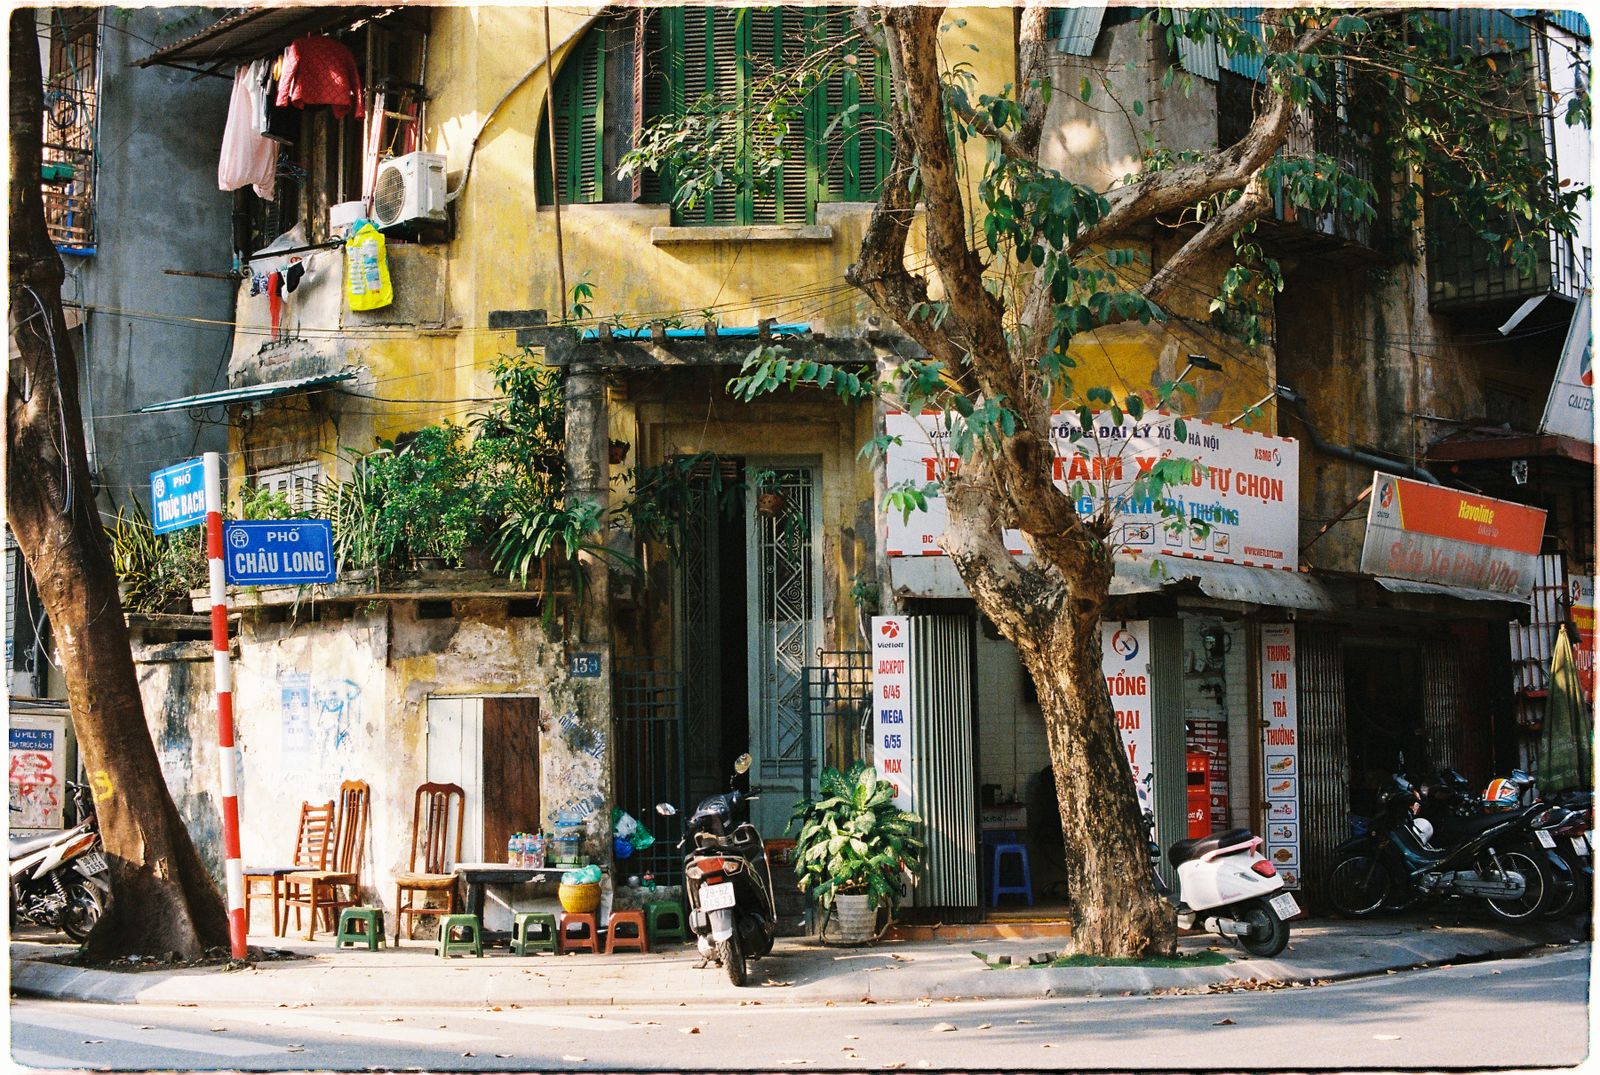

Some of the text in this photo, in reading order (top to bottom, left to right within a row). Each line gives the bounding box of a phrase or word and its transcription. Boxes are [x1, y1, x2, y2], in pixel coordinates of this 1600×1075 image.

[1099, 426, 1127, 441] ĐẠI
[1133, 424, 1151, 438] LÝ
[1203, 435, 1220, 452] NỘI
[1254, 447, 1272, 462] XSMB
[173, 468, 192, 488] PHỐ
[1208, 466, 1232, 497] TỰ
[1235, 472, 1284, 505] CHỌN
[158, 489, 205, 523] TRÚC BẠCH
[1458, 500, 1495, 525] Havoline
[267, 527, 300, 542] PHỐ
[235, 548, 325, 574] CHÂU LONG
[1427, 549, 1449, 577] Xe
[1267, 645, 1291, 661] TRUNG
[878, 660, 905, 675] JACKPOT
[1107, 668, 1146, 696] TỔNG
[1271, 670, 1288, 689] TÂM
[883, 685, 901, 699] 6/45
[881, 709, 904, 724] MEGA
[1273, 695, 1288, 718] TRẢ
[884, 734, 902, 749] 6/55
[1266, 723, 1295, 746] THƯỞNG
[884, 759, 902, 774] MAX
